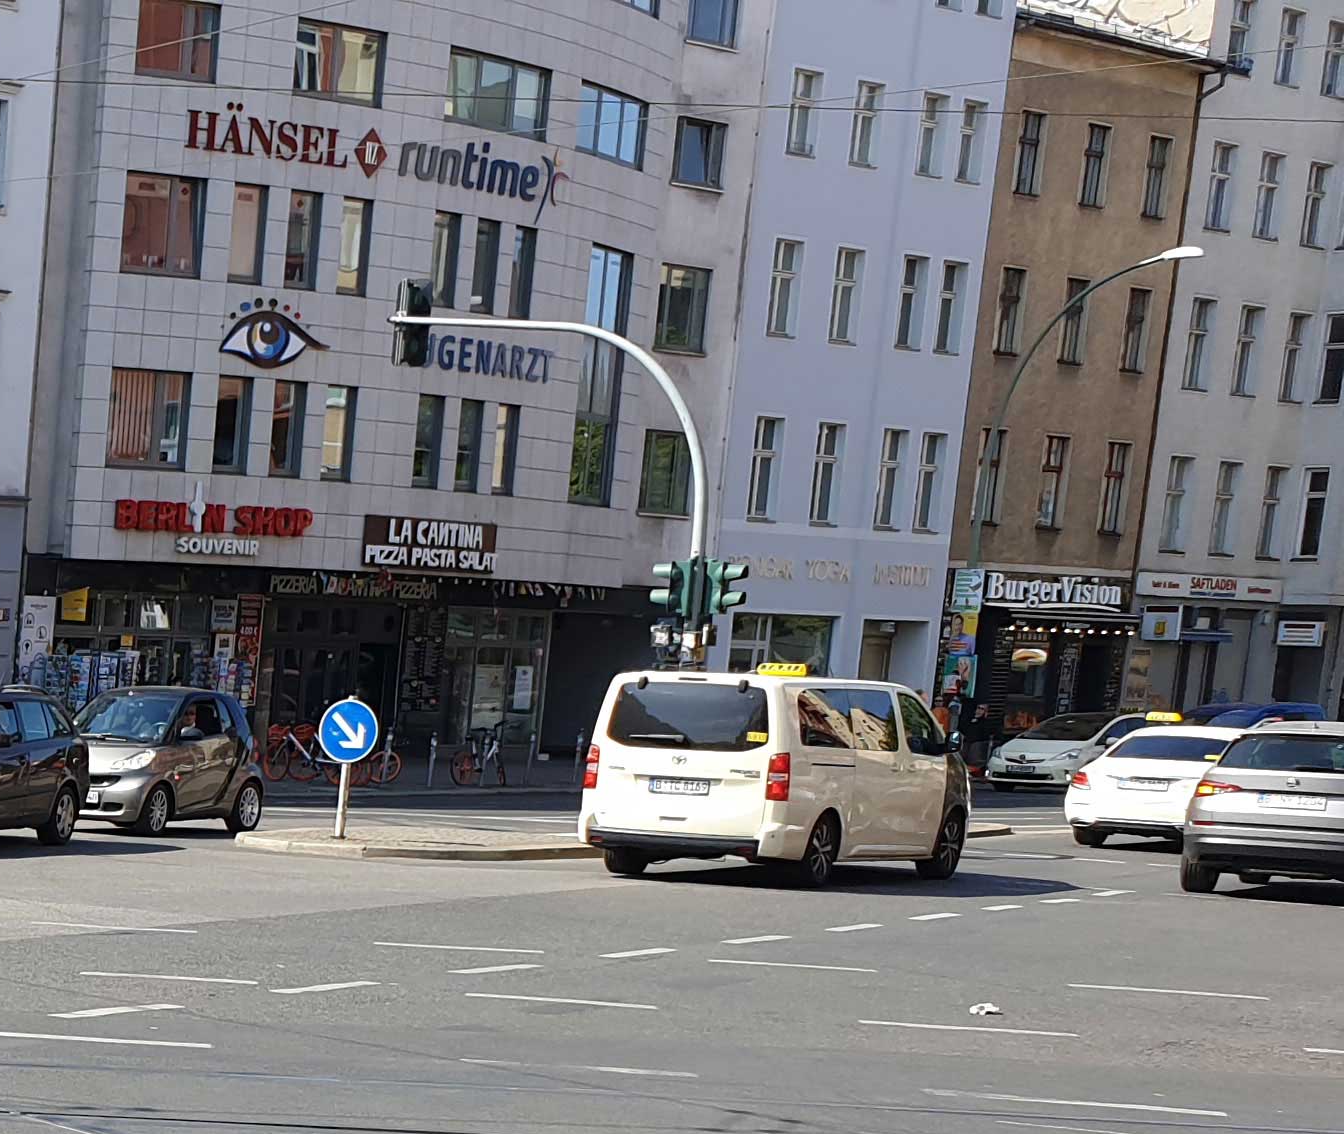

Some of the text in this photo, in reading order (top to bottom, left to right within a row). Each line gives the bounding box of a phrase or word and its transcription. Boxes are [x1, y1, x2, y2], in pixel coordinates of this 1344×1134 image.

[184, 102, 348, 168] HÄNSEL
[397, 141, 540, 201] runtime
[424, 333, 555, 384] UGENARZT
[115, 498, 313, 537] BERLIN SHOP
[388, 518, 483, 549] LA CANTINA
[176, 537, 260, 556] SOUVENIR
[365, 545, 498, 571] PIZZA PASTA SALAT
[269, 574, 318, 593] PIZZERIA
[393, 581, 437, 599] PIZZERIA
[985, 572, 1122, 608] BurgerVision
[1189, 576, 1238, 591] SAFTLADEN
